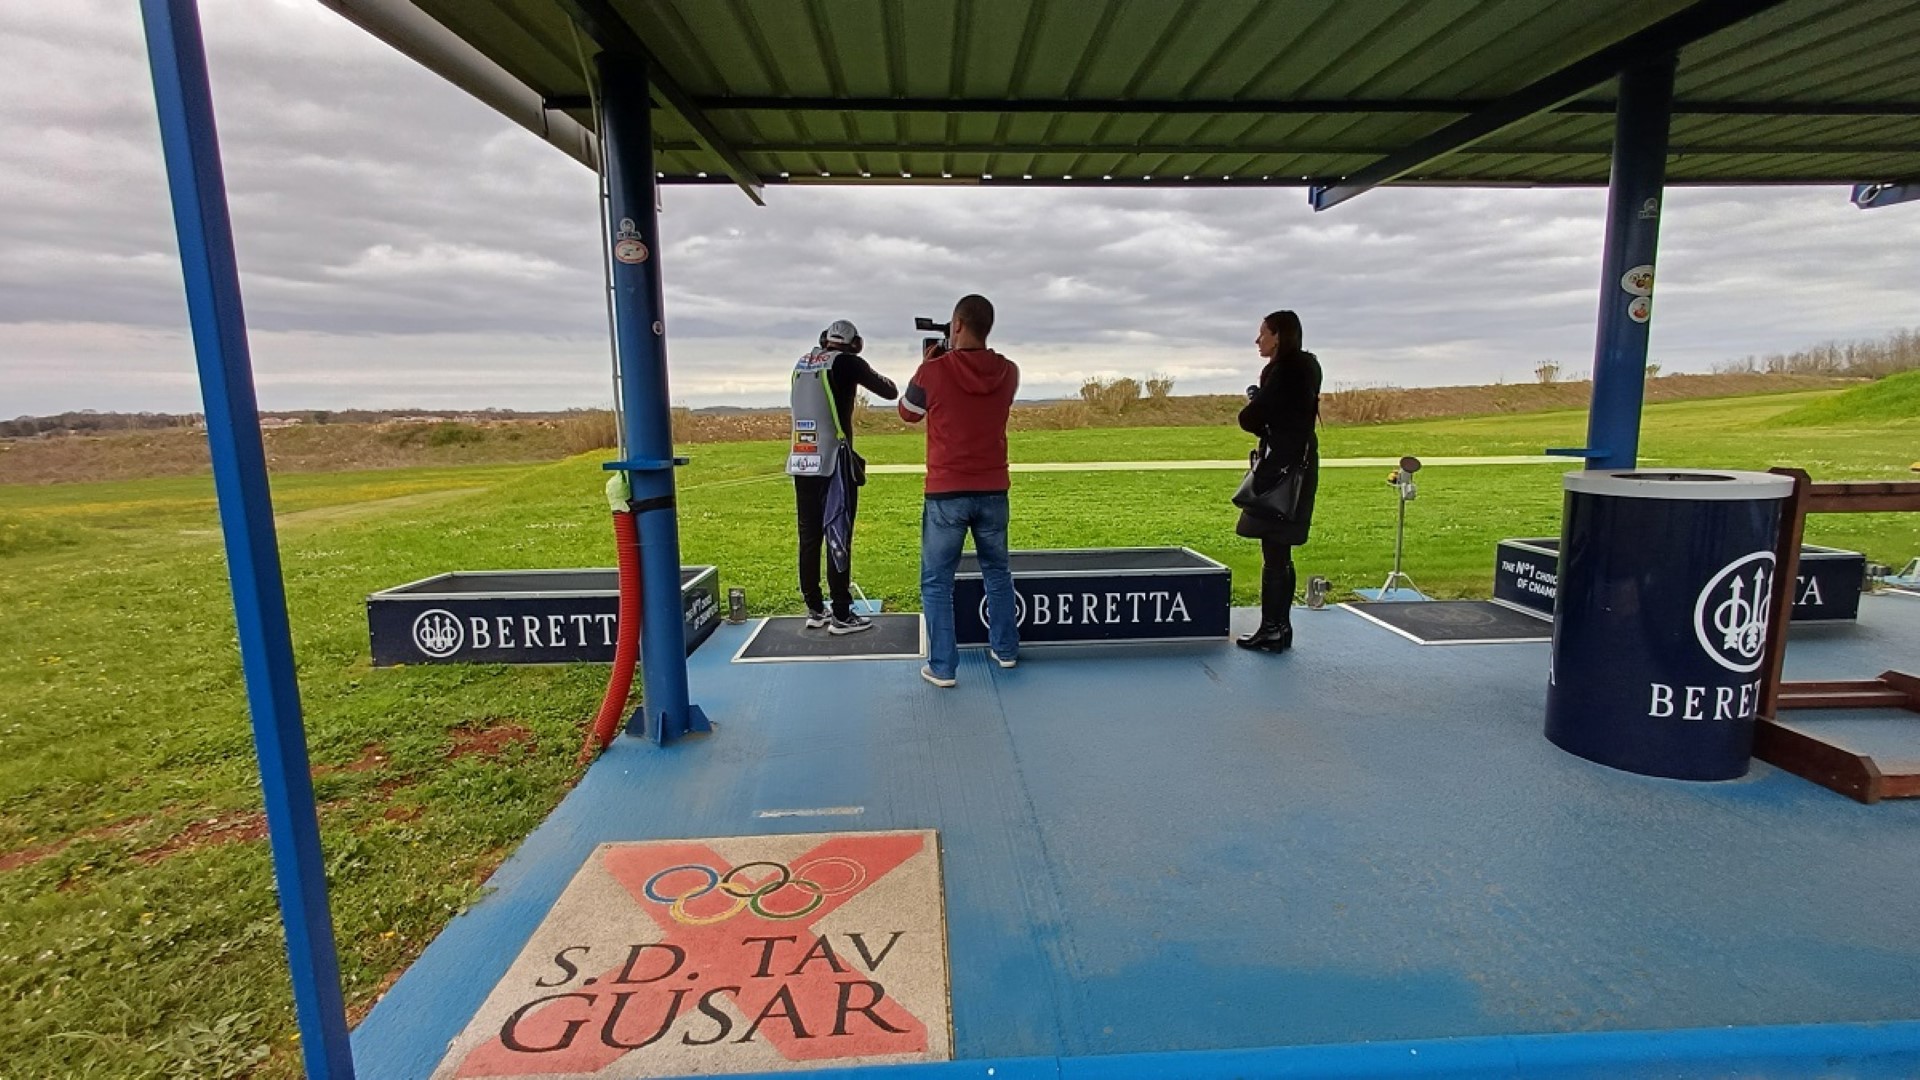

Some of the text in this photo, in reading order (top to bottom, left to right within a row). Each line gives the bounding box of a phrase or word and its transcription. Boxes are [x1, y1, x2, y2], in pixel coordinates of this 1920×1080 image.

[1501, 560, 1516, 573] THE
[1535, 570, 1558, 585] CHOIC
[1517, 577, 1557, 599] OF CHAMP
[1032, 591, 1192, 625] BERETTA
[471, 613, 618, 649] BERETT
[1648, 678, 1762, 721] BERET
[535, 930, 905, 989] S.D. TAV
[499, 979, 912, 1054] GUSAR
